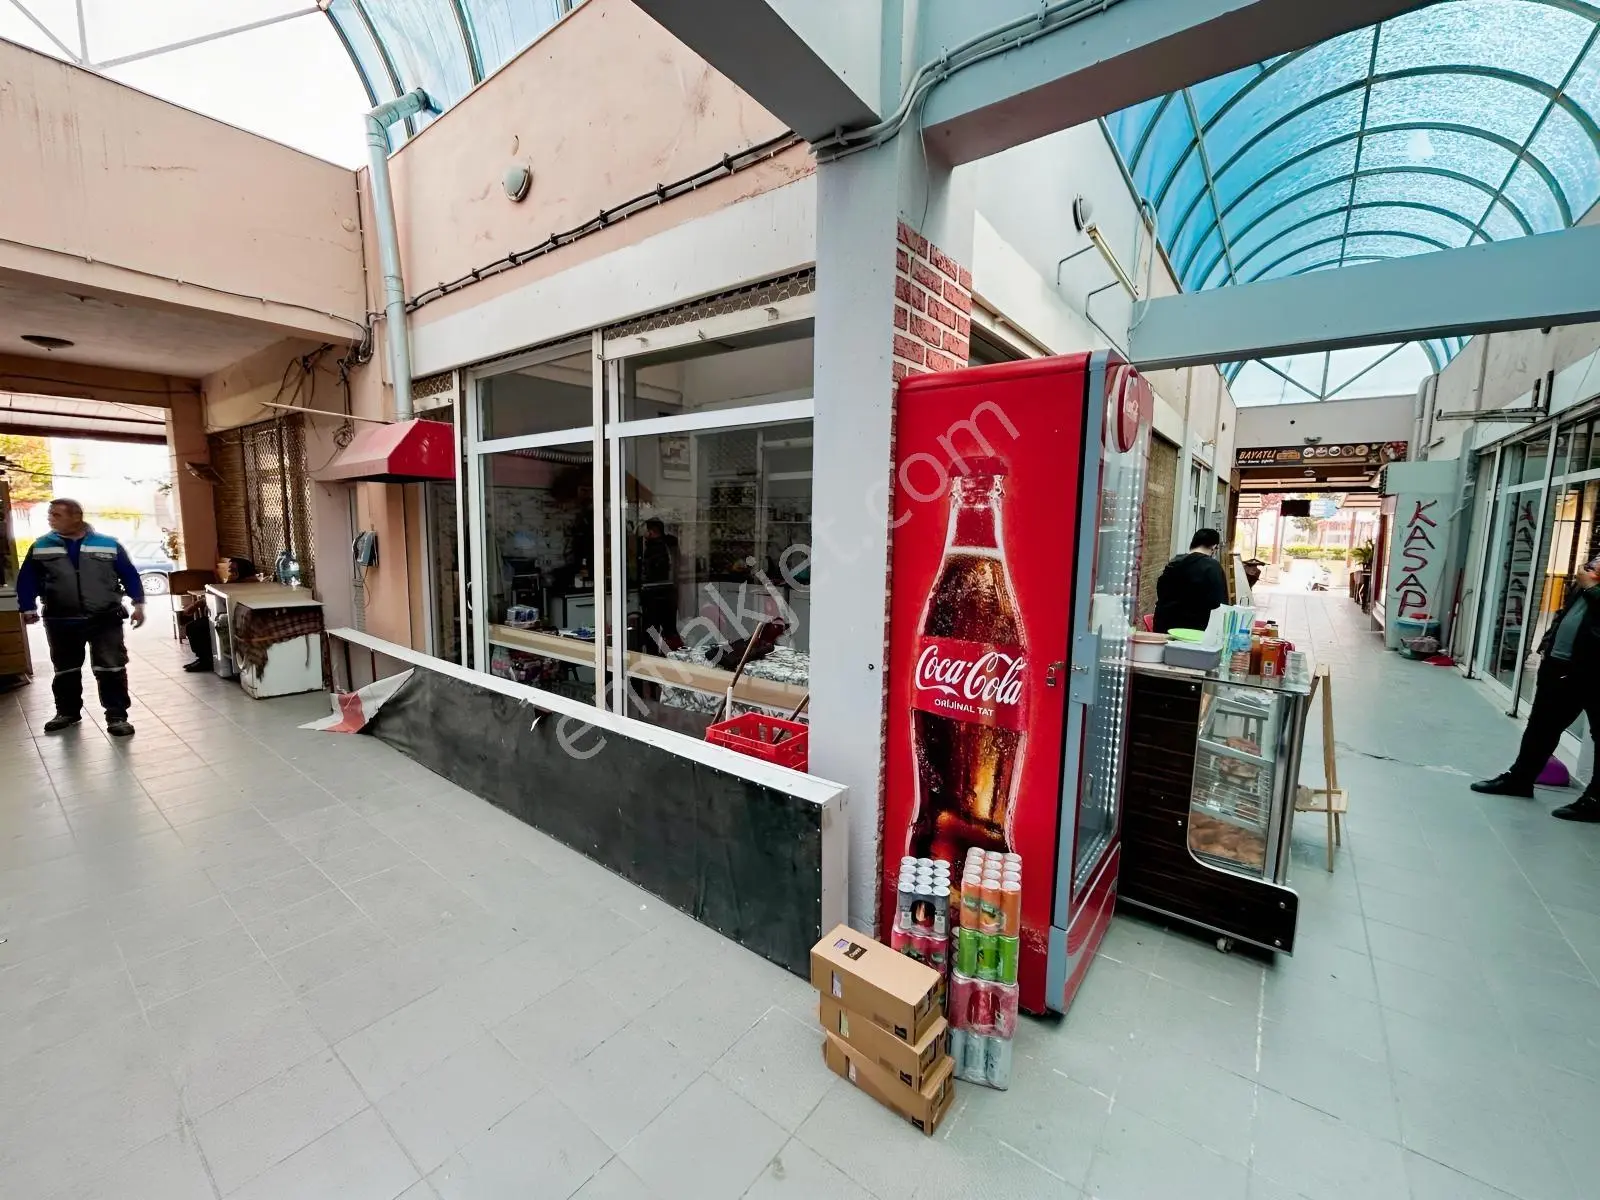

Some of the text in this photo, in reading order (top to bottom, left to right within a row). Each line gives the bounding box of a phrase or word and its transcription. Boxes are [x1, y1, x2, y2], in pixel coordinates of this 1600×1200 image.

[1395, 499, 1438, 618] KASAP
[915, 645, 1026, 705] Coca-Cola
[934, 698, 995, 717] ORİJİNAL TAT
